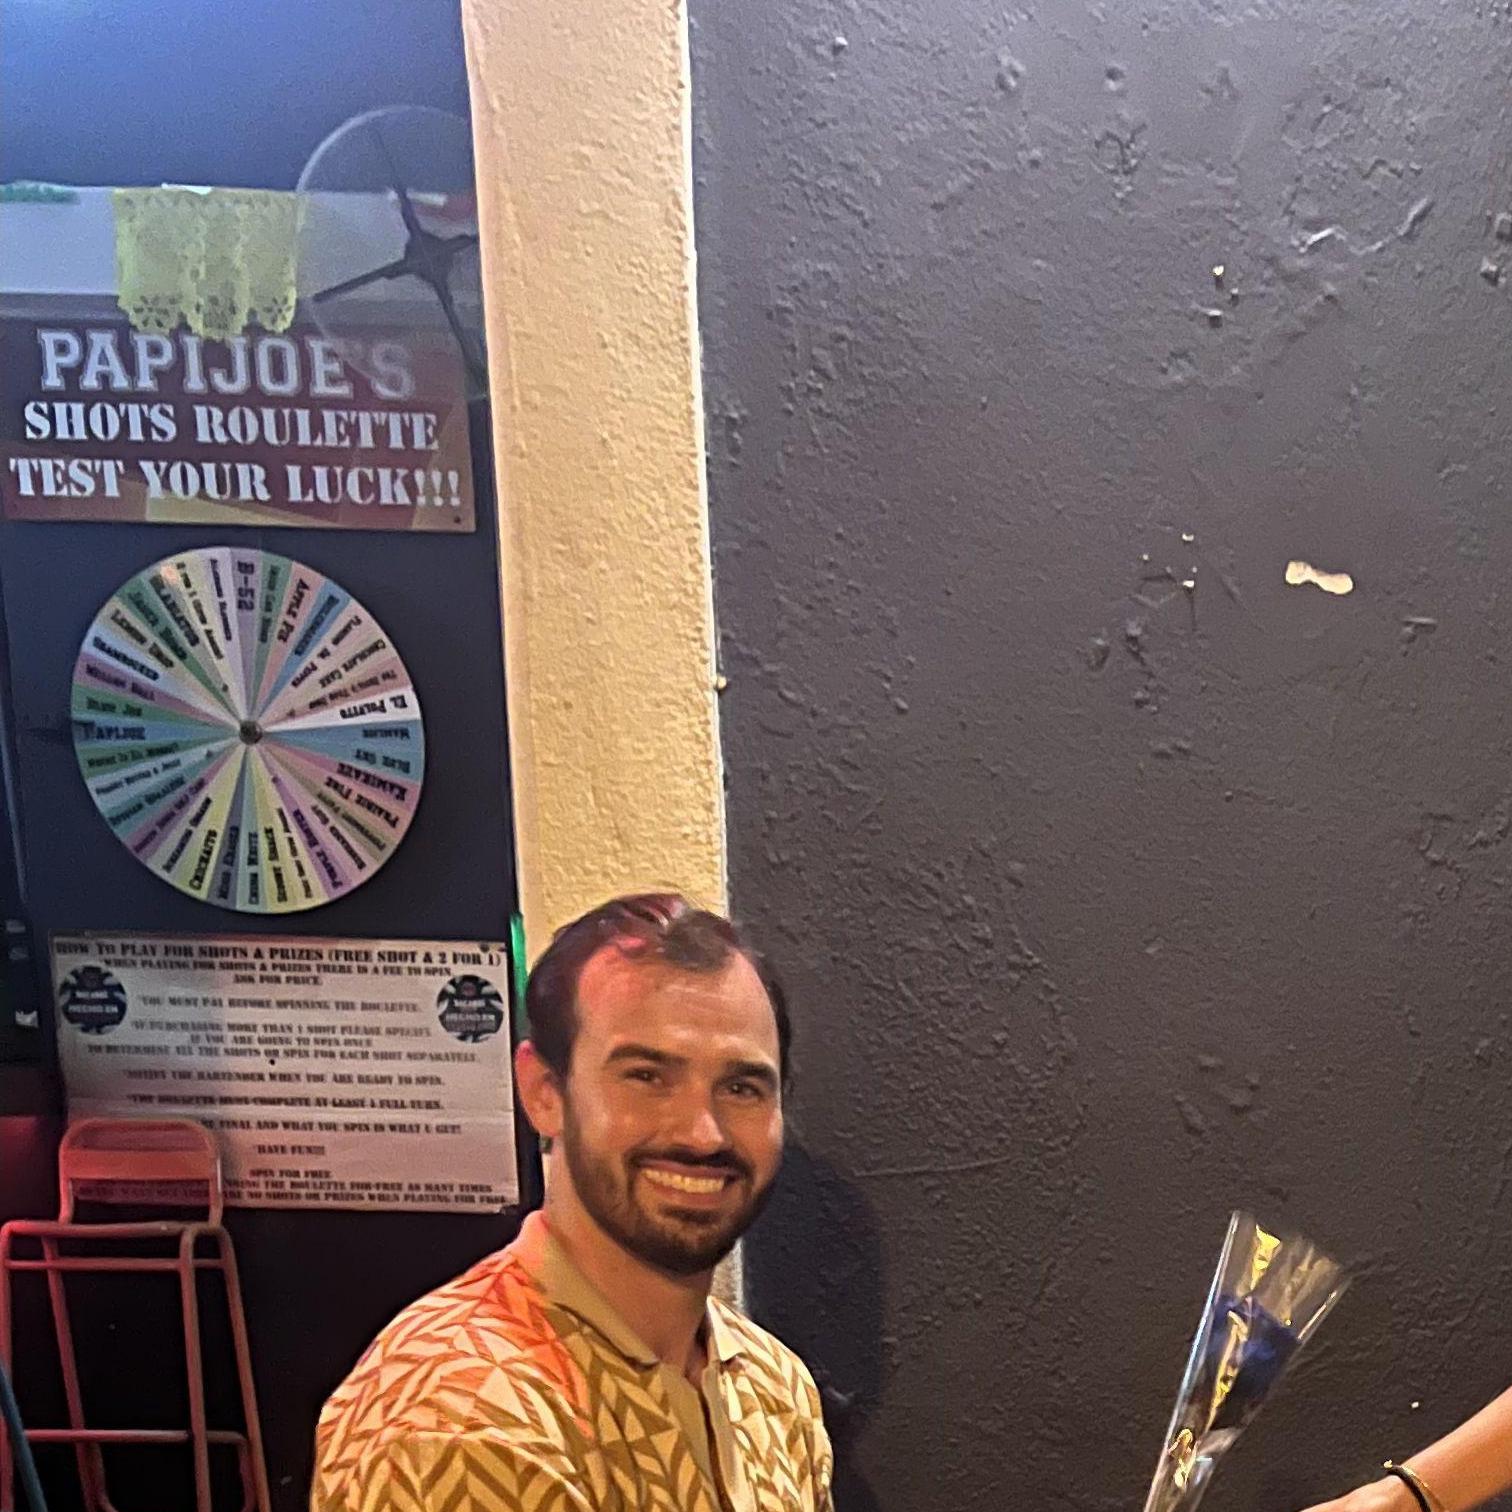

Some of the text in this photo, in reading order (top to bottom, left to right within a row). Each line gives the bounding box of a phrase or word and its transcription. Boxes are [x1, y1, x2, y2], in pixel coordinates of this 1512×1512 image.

[24, 401, 440, 451] SHOTS ROULETTE
[9, 457, 462, 506] TEST YOUR LUCK!!!
[237, 560, 254, 613] B-52
[97, 942, 115, 956] TO
[121, 943, 158, 957] PLAY
[164, 944, 192, 958] FOR
[199, 945, 247, 959] SHOTS
[254, 946, 263, 960] &
[270, 947, 322, 961] PRIZES
[329, 948, 372, 963] (FREE
[378, 950, 416, 964] SHOT
[423, 951, 432, 964] &
[439, 951, 446, 964] 2
[453, 952, 482, 965] FOR
